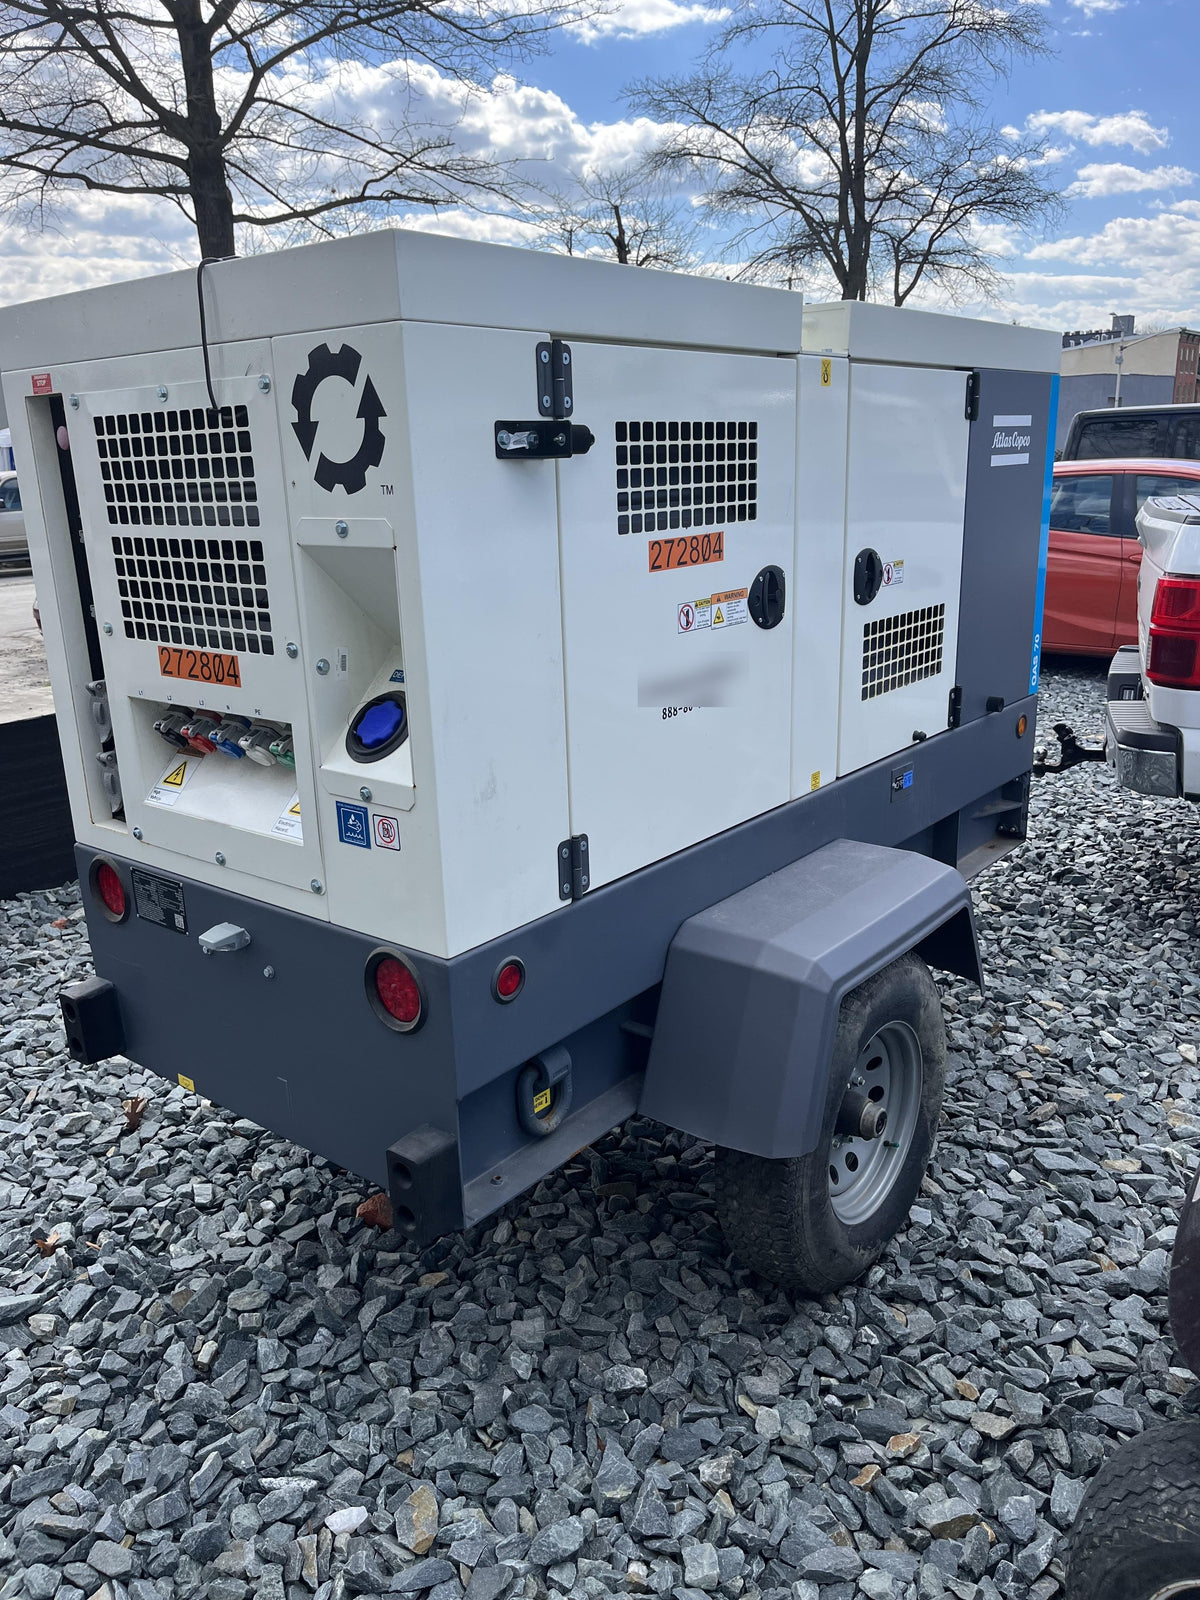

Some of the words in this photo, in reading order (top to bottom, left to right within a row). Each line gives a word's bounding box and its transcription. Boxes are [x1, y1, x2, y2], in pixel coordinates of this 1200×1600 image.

[380, 484, 394, 496] TM
[651, 533, 723, 570] 272804
[724, 590, 744, 601] WARNING
[1033, 633, 1040, 652] 70
[161, 647, 239, 685] 272804
